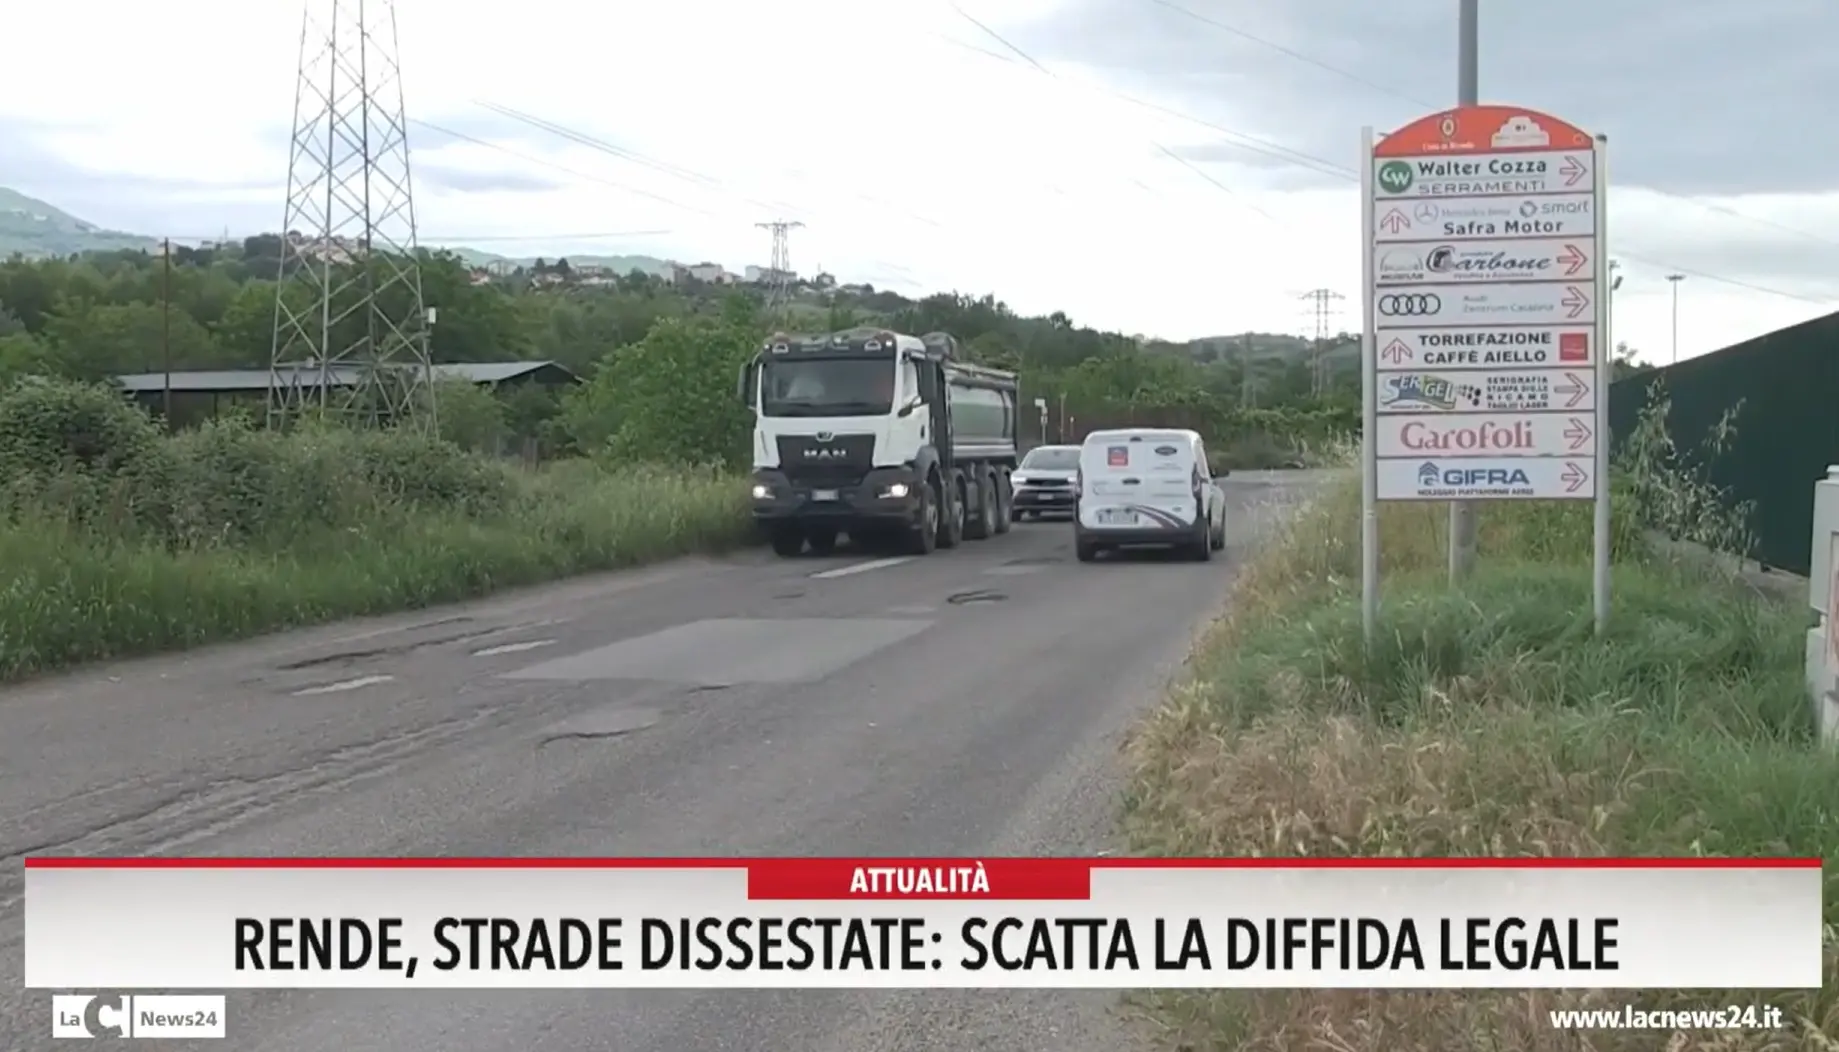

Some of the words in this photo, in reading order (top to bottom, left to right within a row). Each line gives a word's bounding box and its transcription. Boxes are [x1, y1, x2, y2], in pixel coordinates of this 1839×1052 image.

[1418, 161, 1480, 177] Walter
[1488, 159, 1547, 174] Cozza
[1418, 180, 1545, 195] SERRAMENTI
[1541, 201, 1589, 215] smart
[1444, 221, 1496, 236] Safra
[1504, 220, 1564, 234] Motor
[1418, 332, 1552, 346] TORREFAZIONE
[1484, 350, 1547, 363] AIELLO
[1400, 420, 1535, 450] Garofoli
[803, 449, 847, 460] MAN
[1444, 468, 1530, 486] GIFRA
